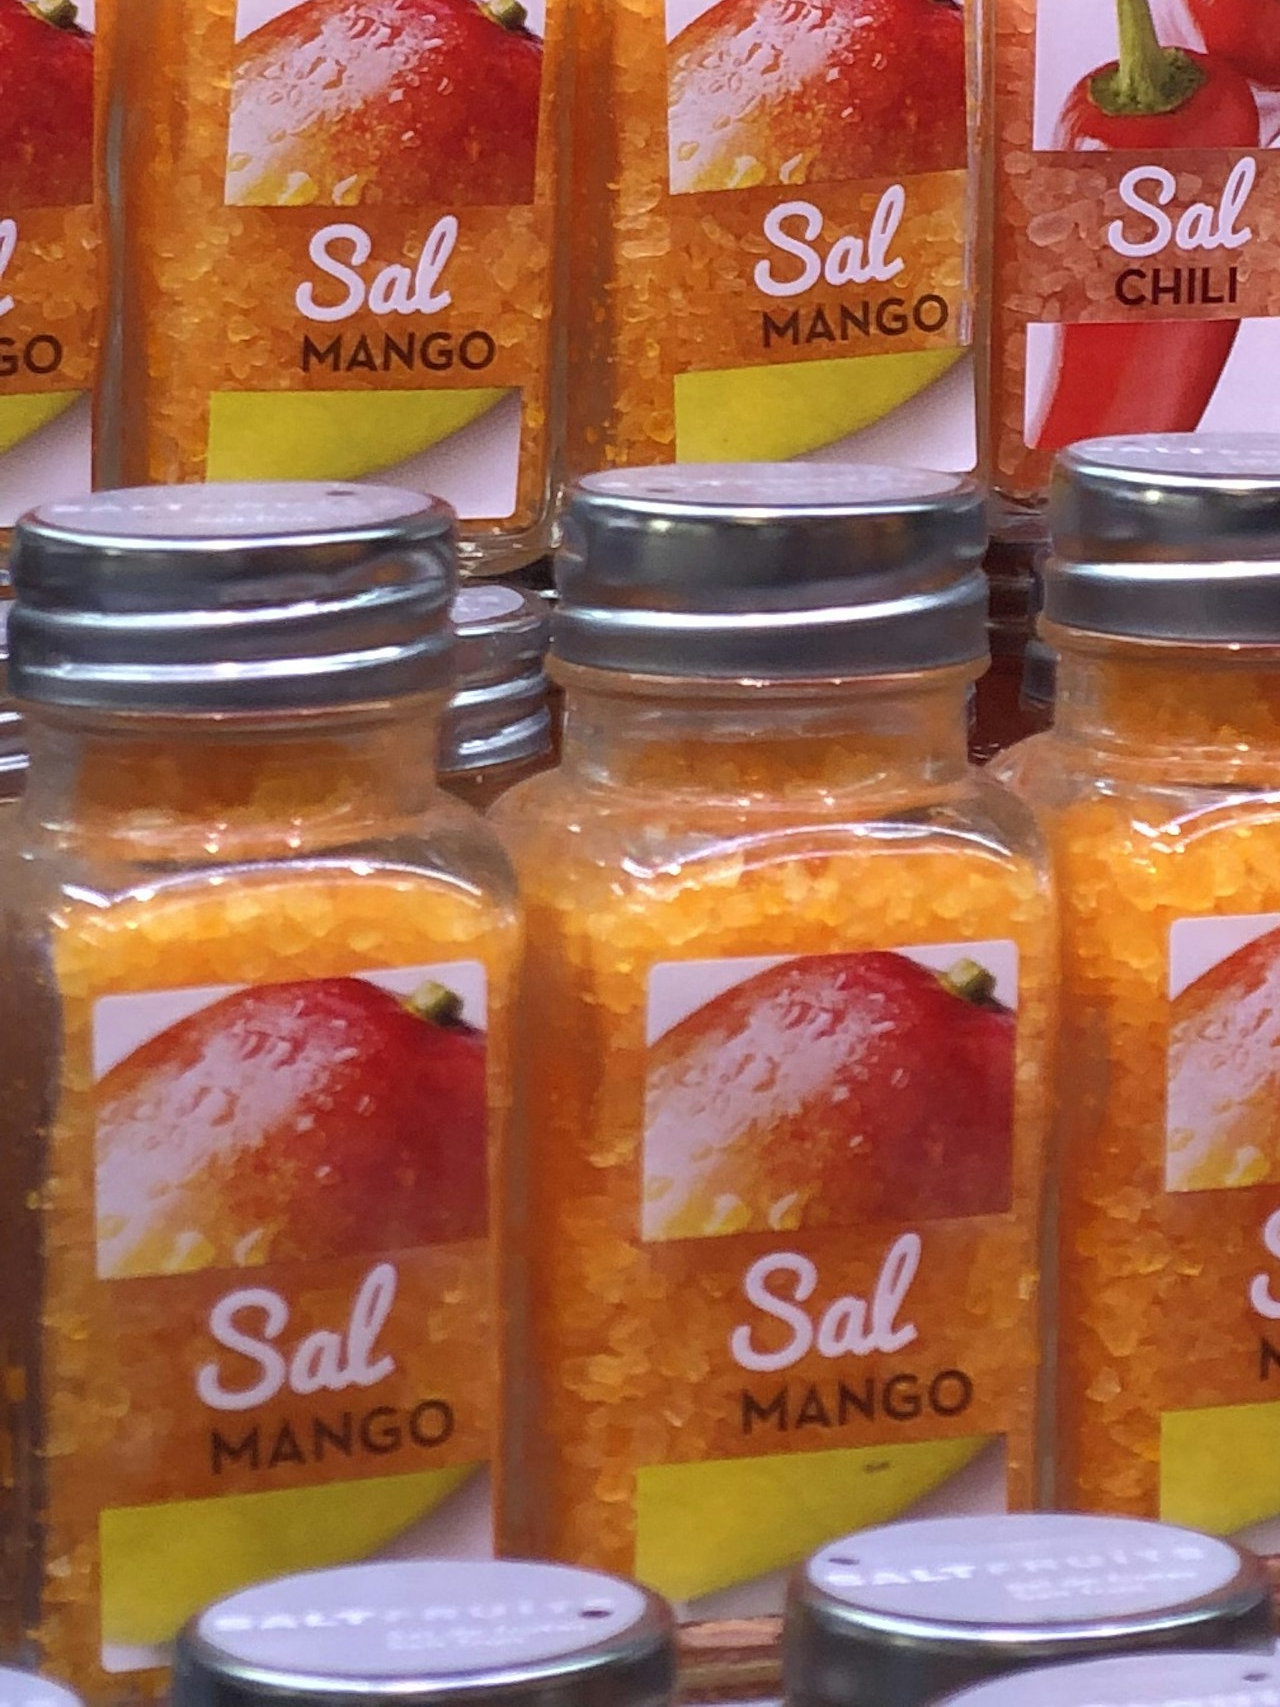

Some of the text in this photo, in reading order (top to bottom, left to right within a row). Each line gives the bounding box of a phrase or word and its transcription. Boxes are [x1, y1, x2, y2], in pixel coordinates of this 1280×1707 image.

[754, 184, 906, 296] Sal
[1108, 155, 1255, 258] Sal
[296, 215, 459, 321] Sal
[1114, 266, 1240, 306] CHILI
[301, 331, 496, 372] MANGO
[761, 295, 949, 347] MANGO
[195, 1264, 397, 1411] Sal
[730, 1233, 921, 1372] Sal
[209, 1398, 454, 1475] MANGO
[739, 1370, 973, 1436] MANGO
